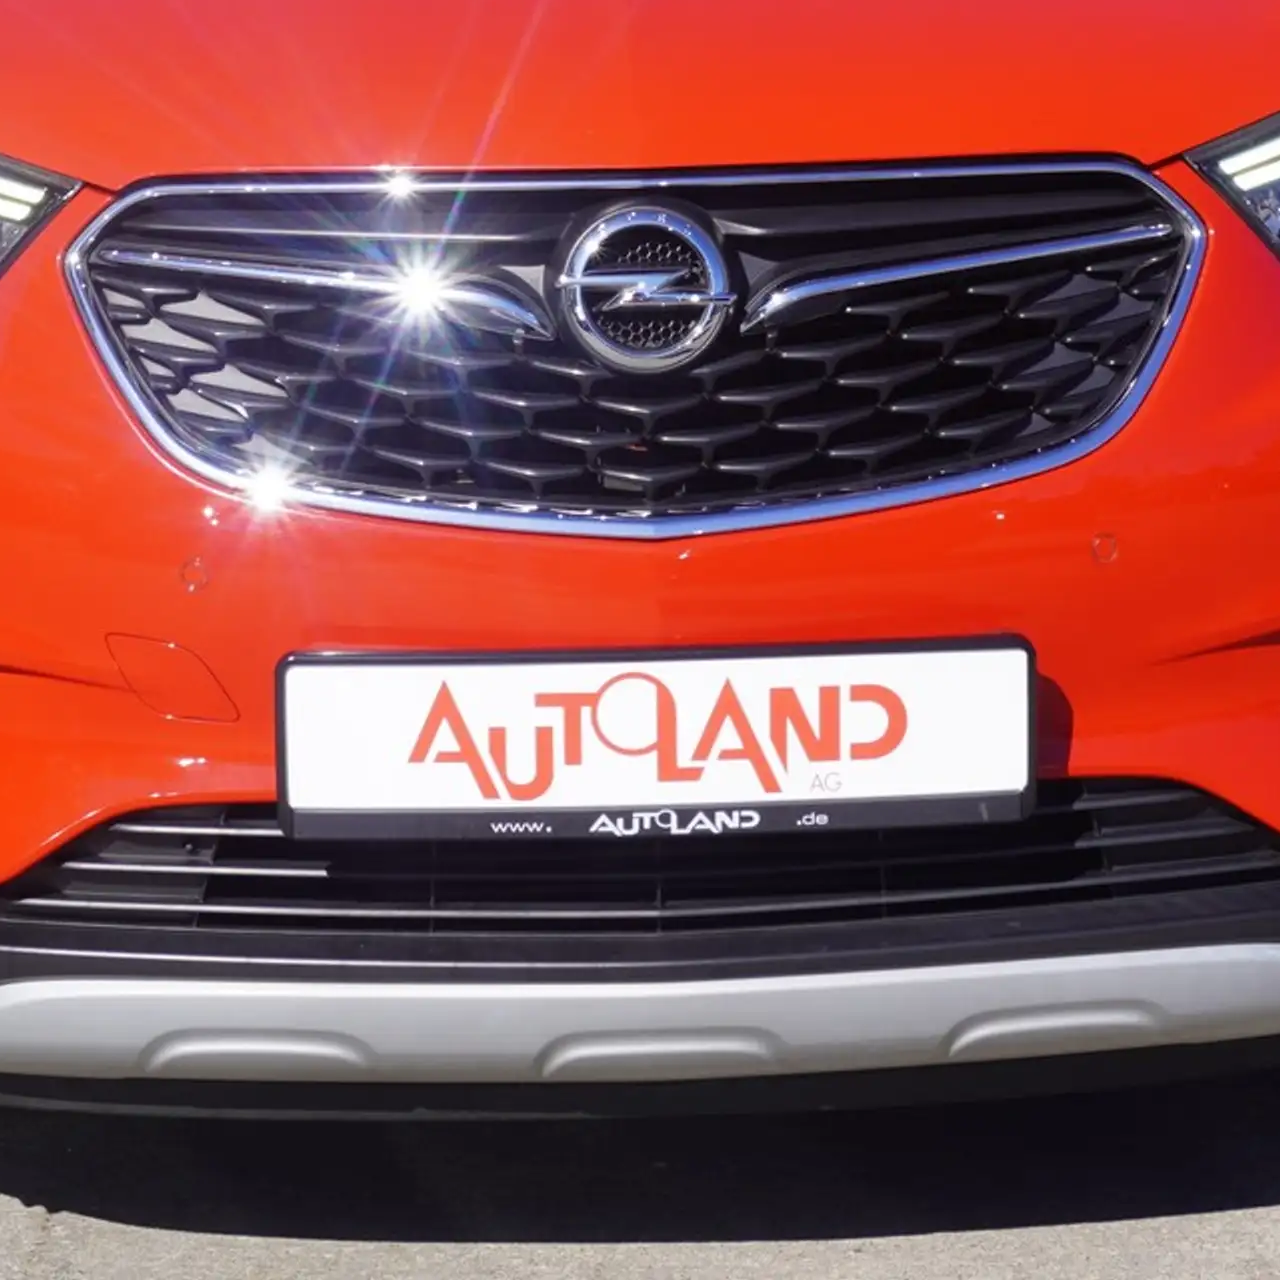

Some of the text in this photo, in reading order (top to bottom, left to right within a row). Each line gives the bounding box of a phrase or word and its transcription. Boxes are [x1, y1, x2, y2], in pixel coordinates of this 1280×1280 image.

[407, 672, 908, 801] AUTOLAND
[809, 772, 843, 792] AG
[489, 808, 830, 838] www. AUTOLAND .de
